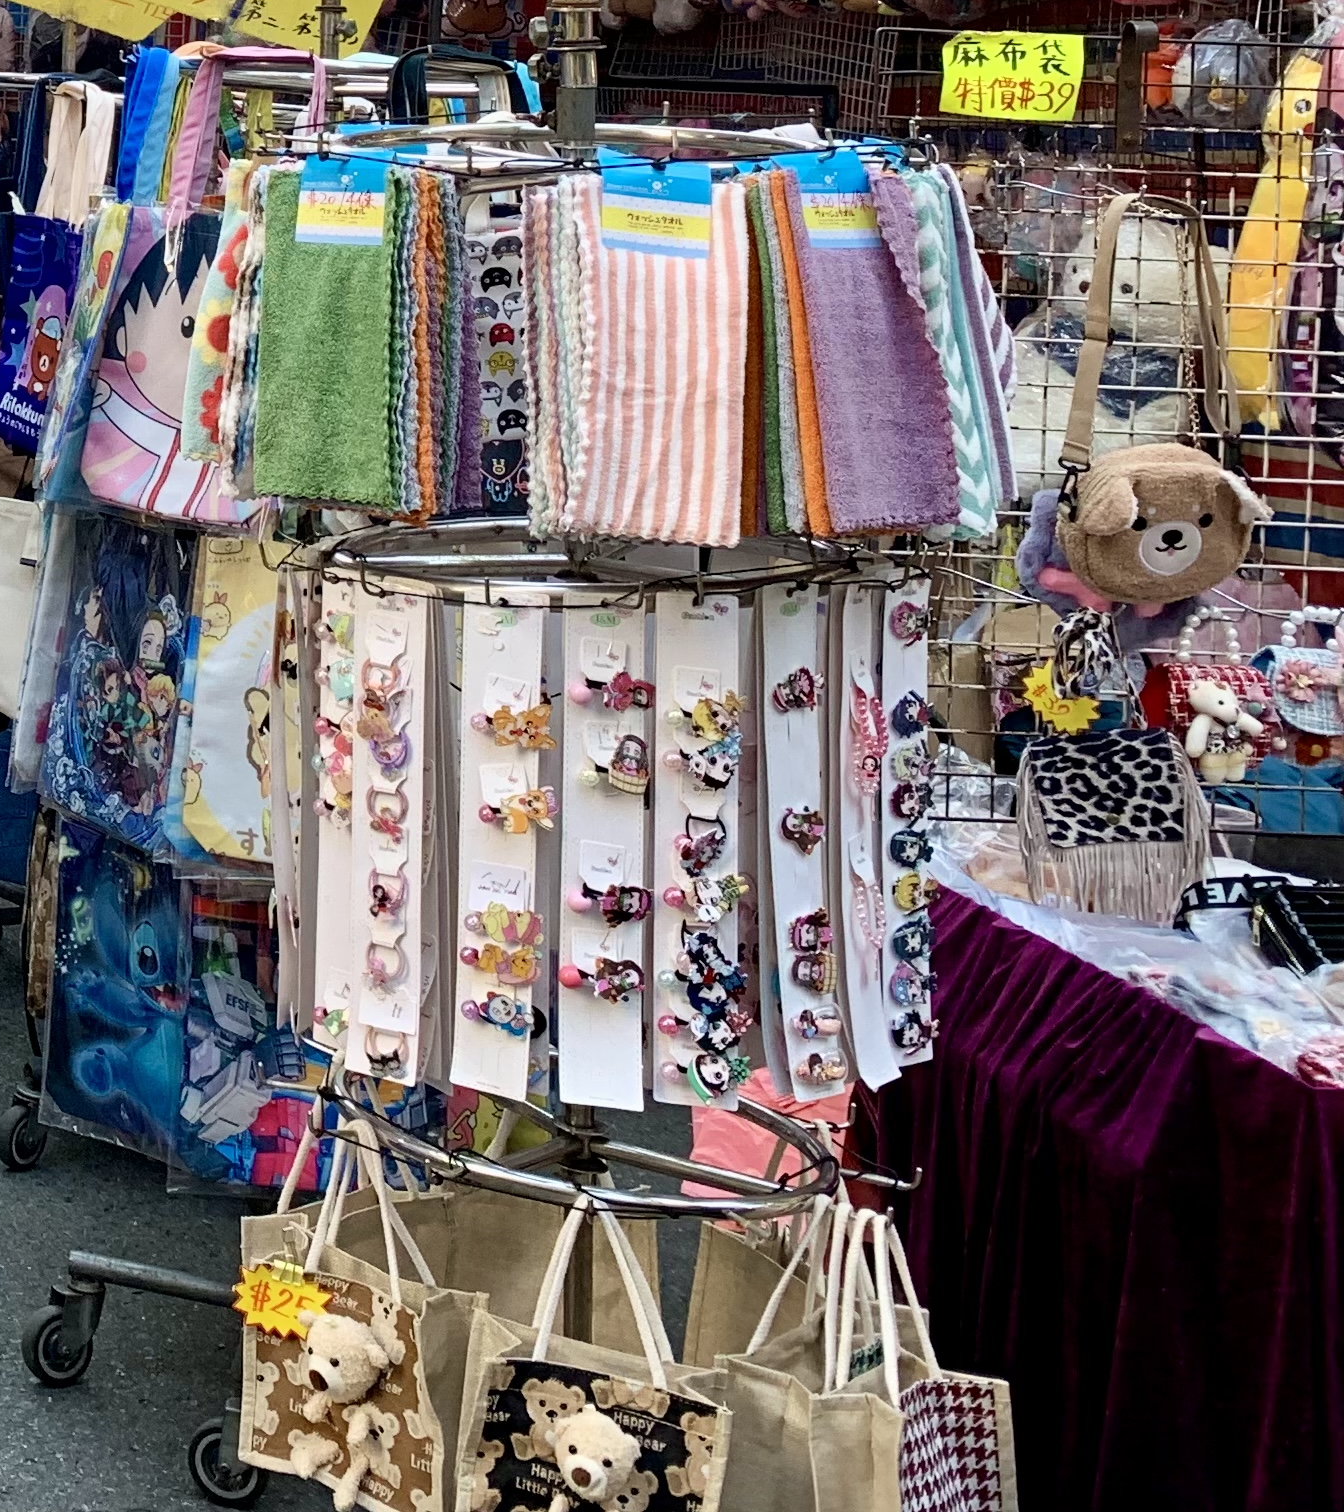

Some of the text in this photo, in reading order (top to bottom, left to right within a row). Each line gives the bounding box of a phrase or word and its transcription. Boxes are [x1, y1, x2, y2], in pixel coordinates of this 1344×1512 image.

[949, 36, 1071, 76] 麻布袋
[314, 1273, 351, 1293] Happy
[614, 1411, 656, 1436] Happy
[410, 1453, 433, 1473] Litt
